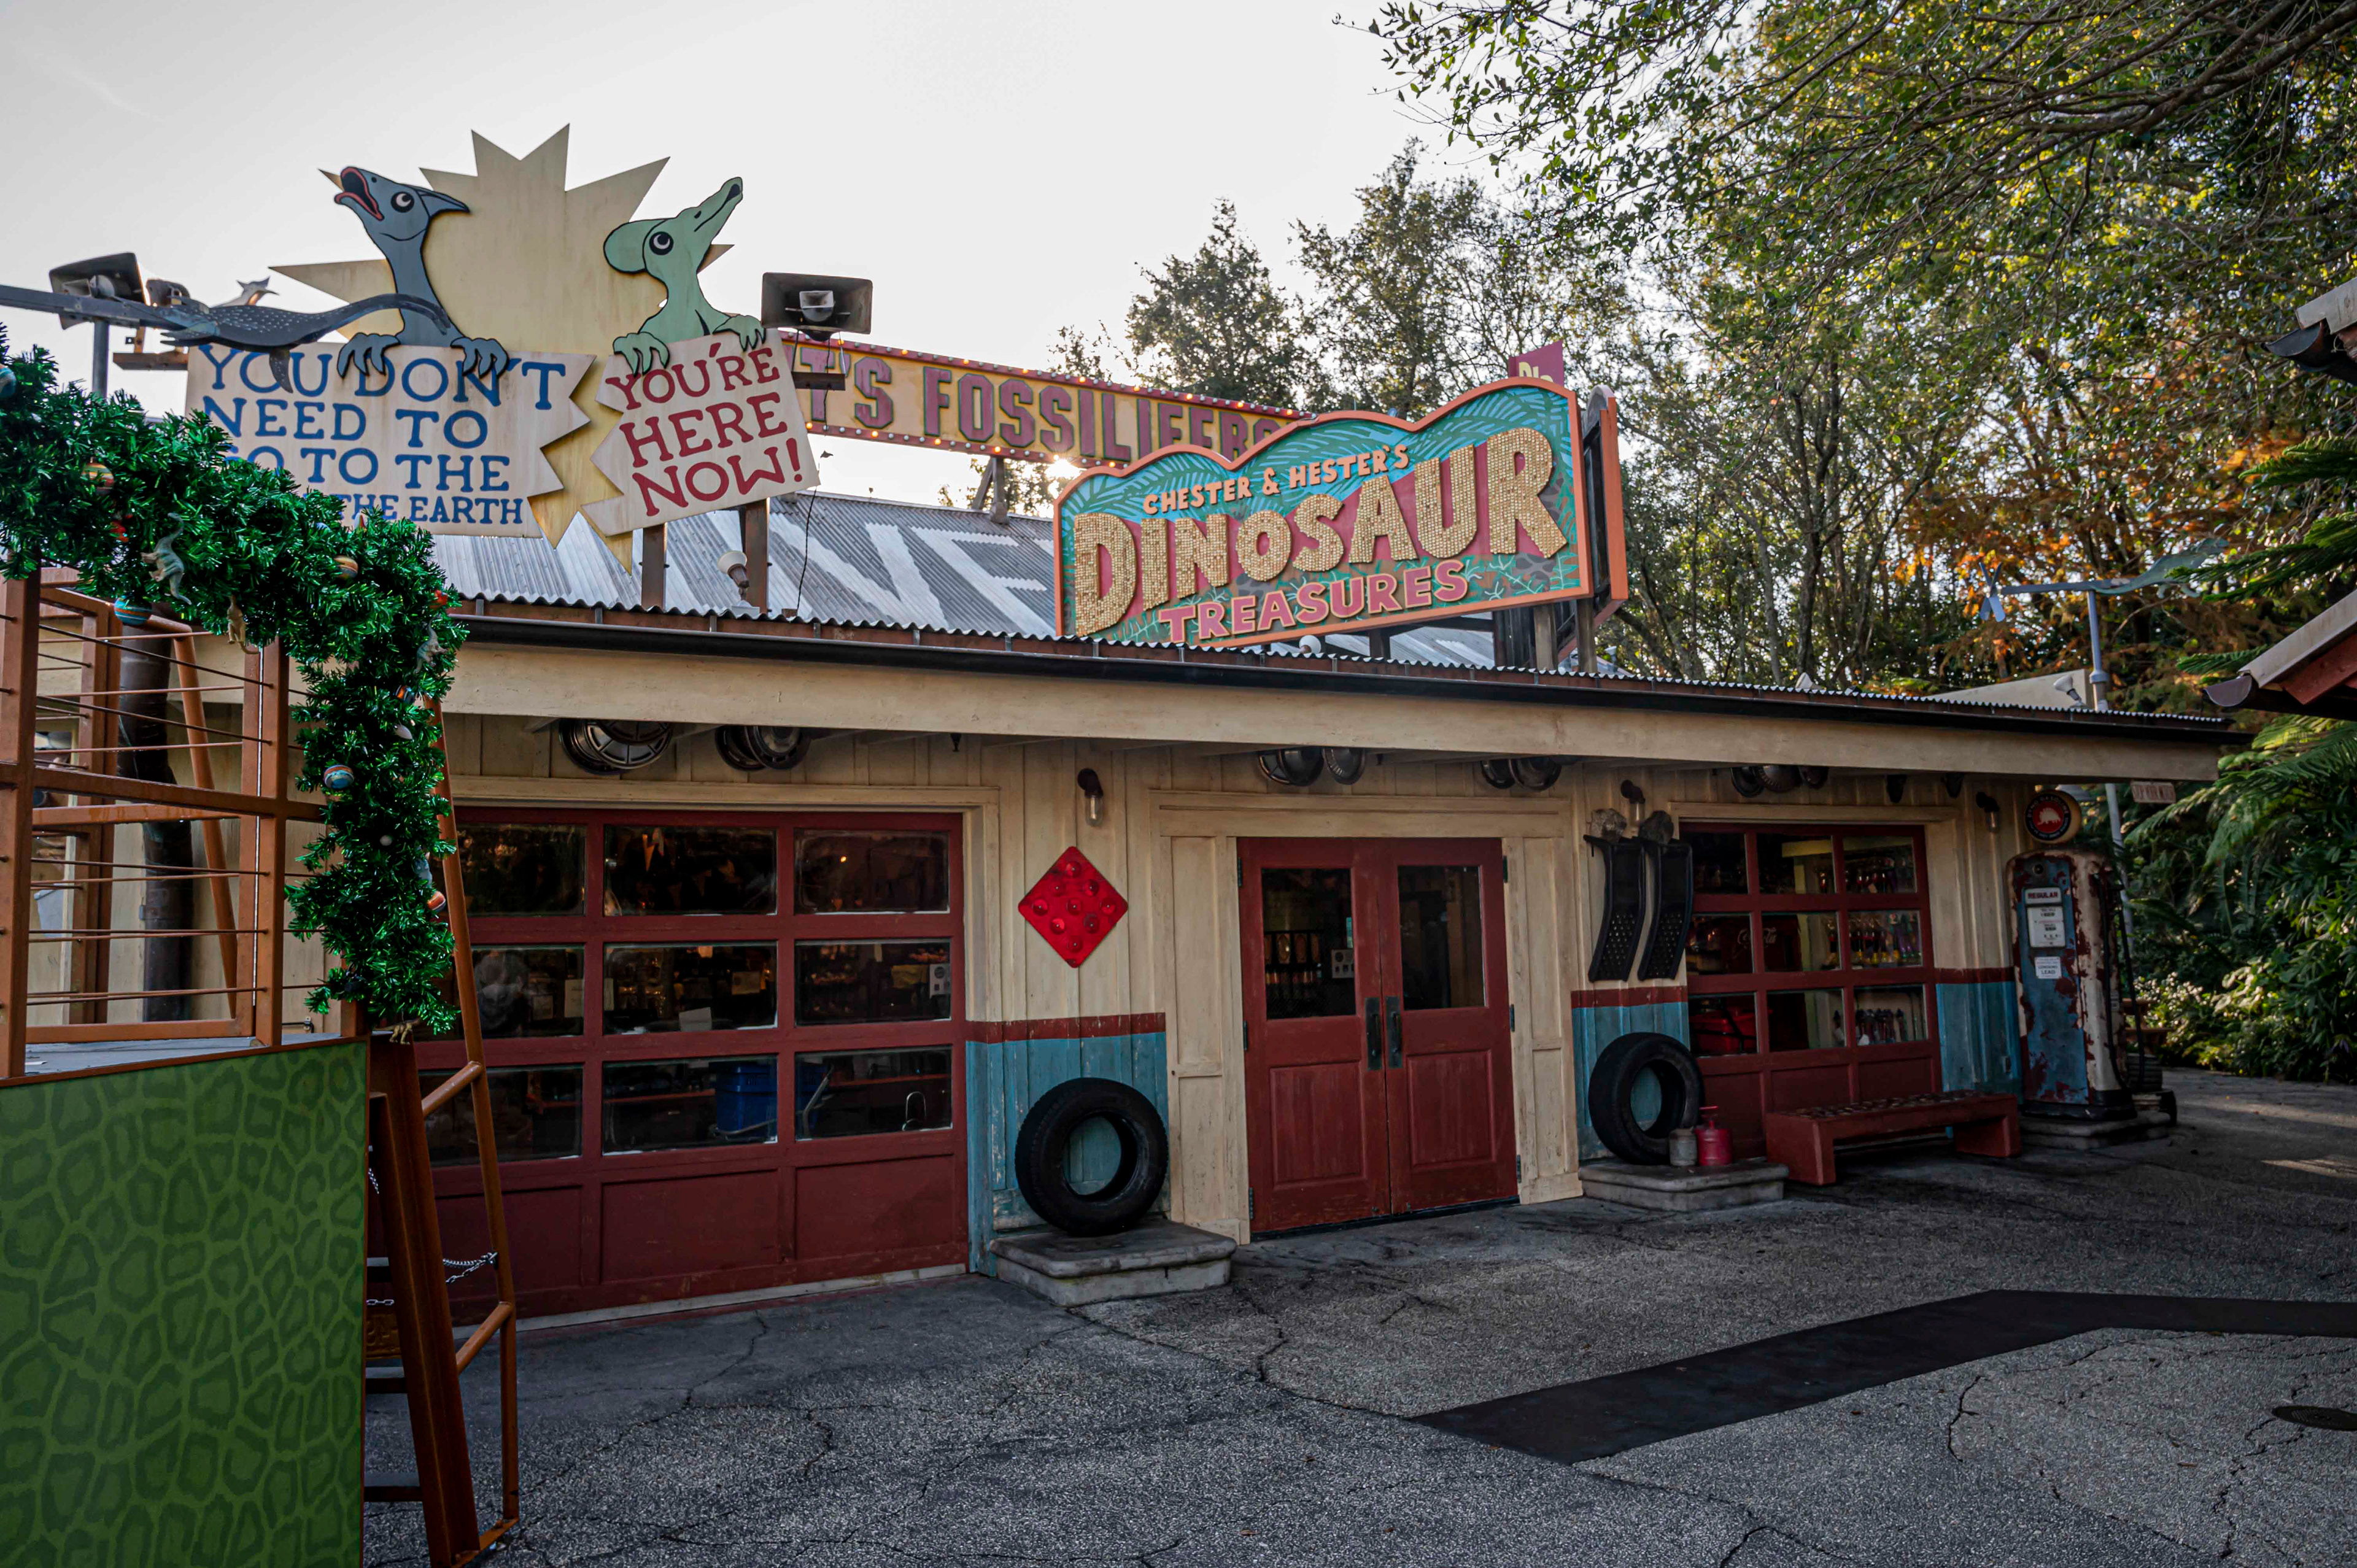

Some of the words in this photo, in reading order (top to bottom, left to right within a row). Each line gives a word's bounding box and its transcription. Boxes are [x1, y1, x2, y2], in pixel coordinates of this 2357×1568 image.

[198, 344, 333, 398] YOU
[354, 356, 566, 411] DON'T
[605, 342, 780, 410] YOU'RE
[203, 396, 366, 441] NEED
[395, 409, 488, 449] TO
[619, 392, 788, 468] HERE
[300, 447, 379, 485] TO
[395, 454, 510, 492] THE
[632, 438, 803, 516] NOW!
[1143, 477, 1252, 515] CHESTER
[1262, 467, 1280, 496] &
[1289, 444, 1410, 489] HESTER'S
[409, 496, 524, 523] EARTH
[1074, 428, 1568, 636] DINOSAUR
[1158, 560, 1468, 643] TREASURES
